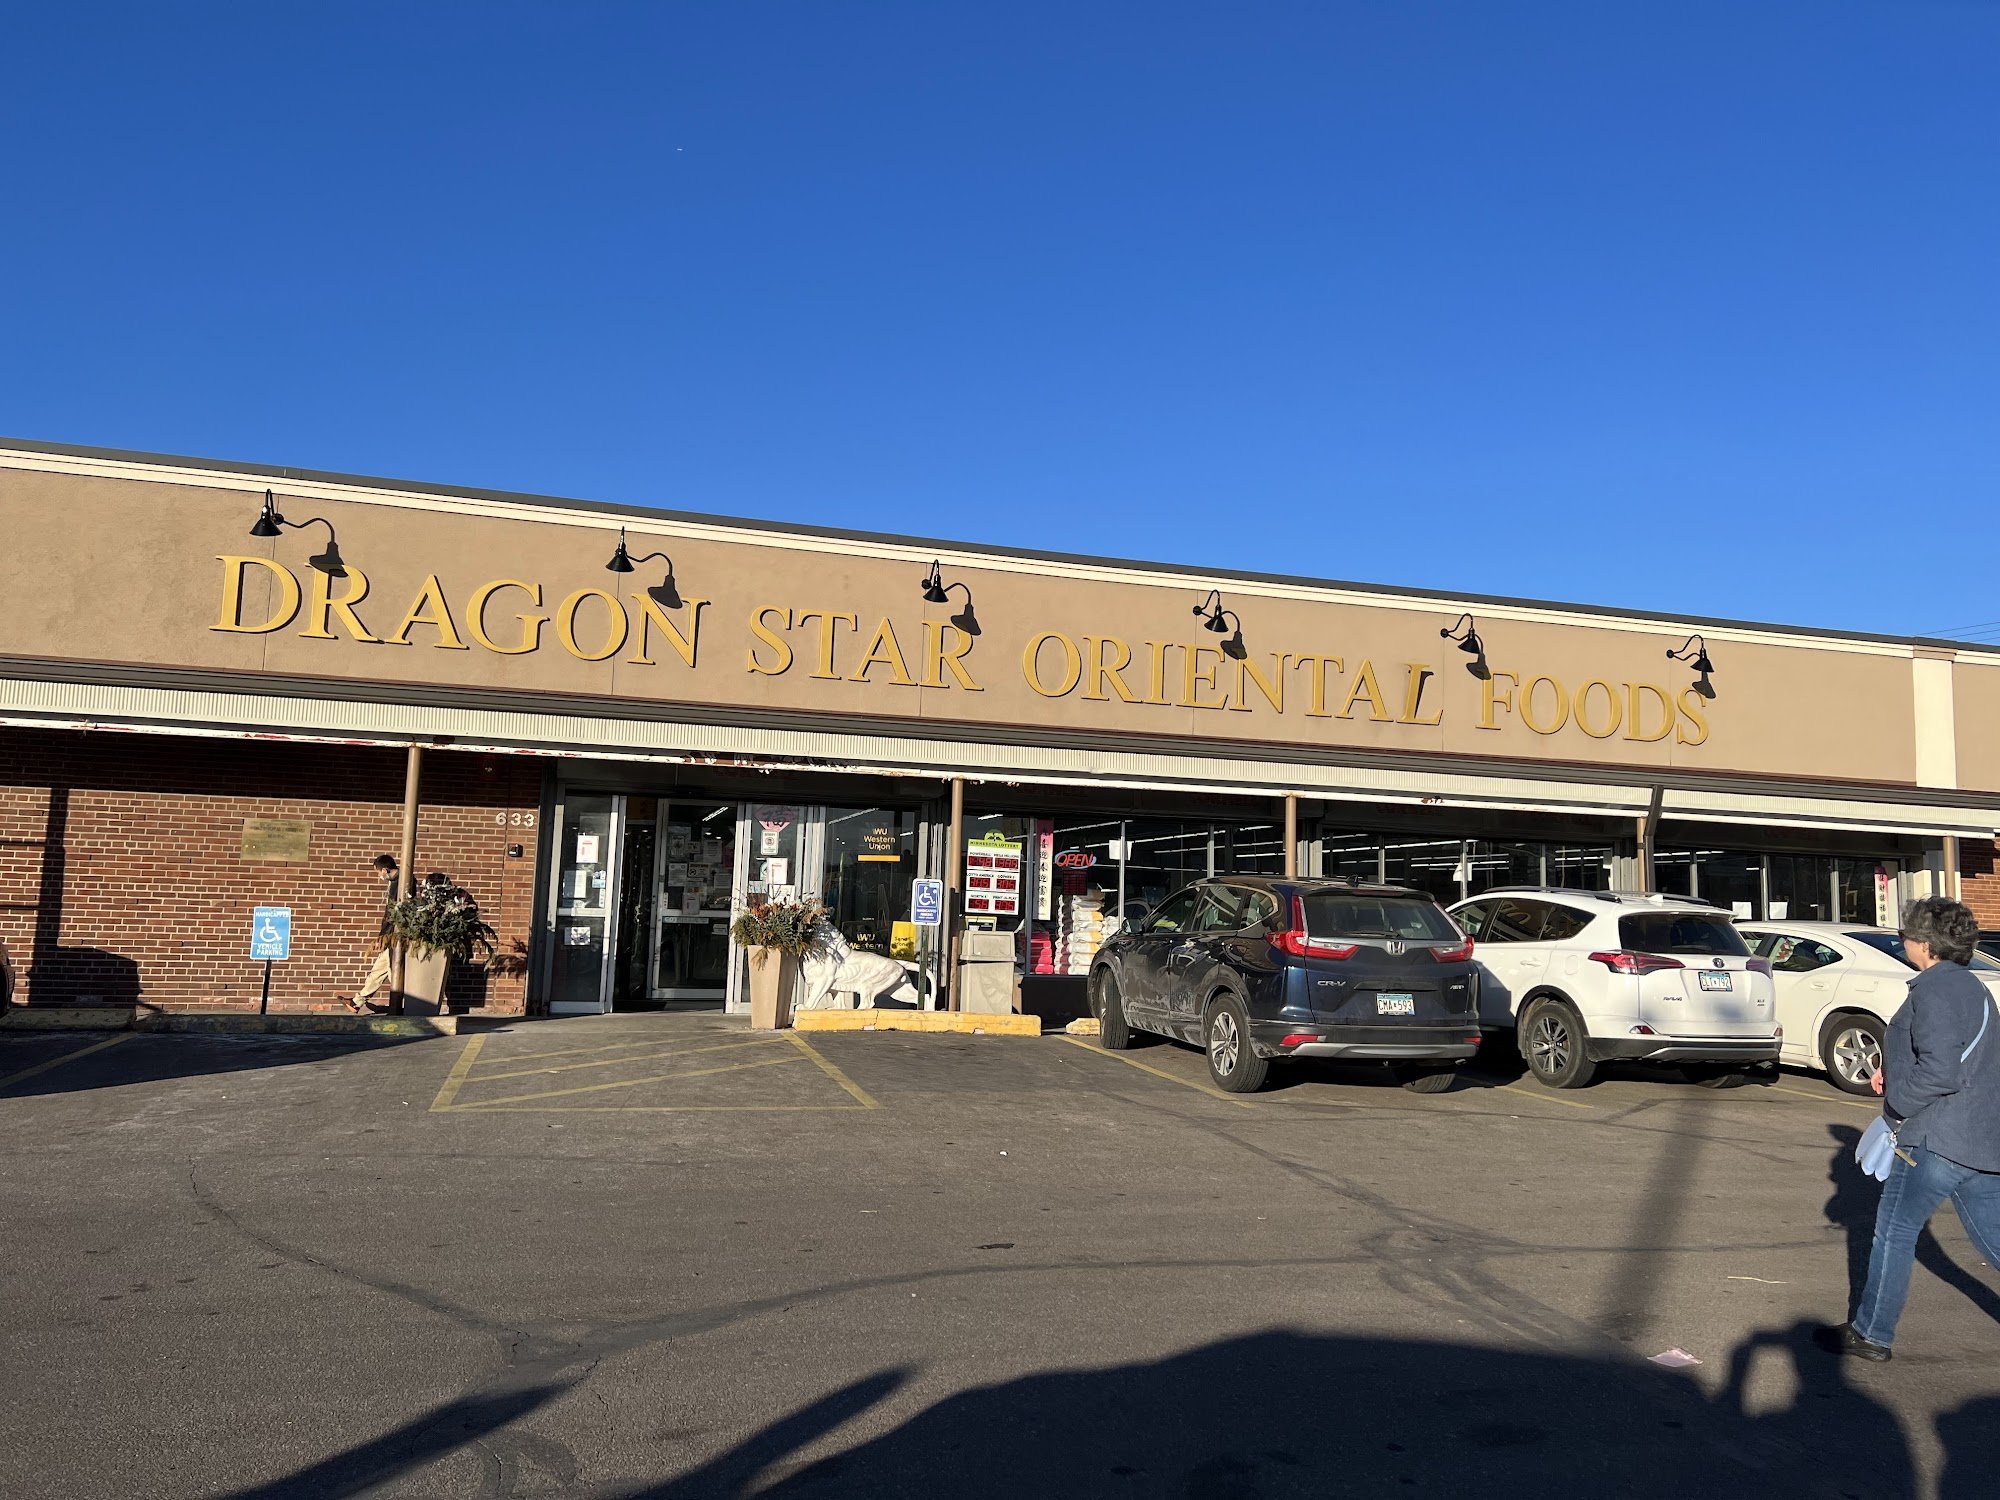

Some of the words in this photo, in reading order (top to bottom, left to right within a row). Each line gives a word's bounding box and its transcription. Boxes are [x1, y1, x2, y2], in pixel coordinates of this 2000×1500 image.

[209, 554, 710, 668] DRAGON
[746, 604, 987, 692] STAR
[1022, 631, 1444, 727] ORIENTAL
[1475, 670, 1711, 746] FOODS
[495, 812, 535, 827] 633
[863, 835, 896, 843] Western
[1055, 853, 1094, 867] OPEN
[848, 942, 884, 950] Western
